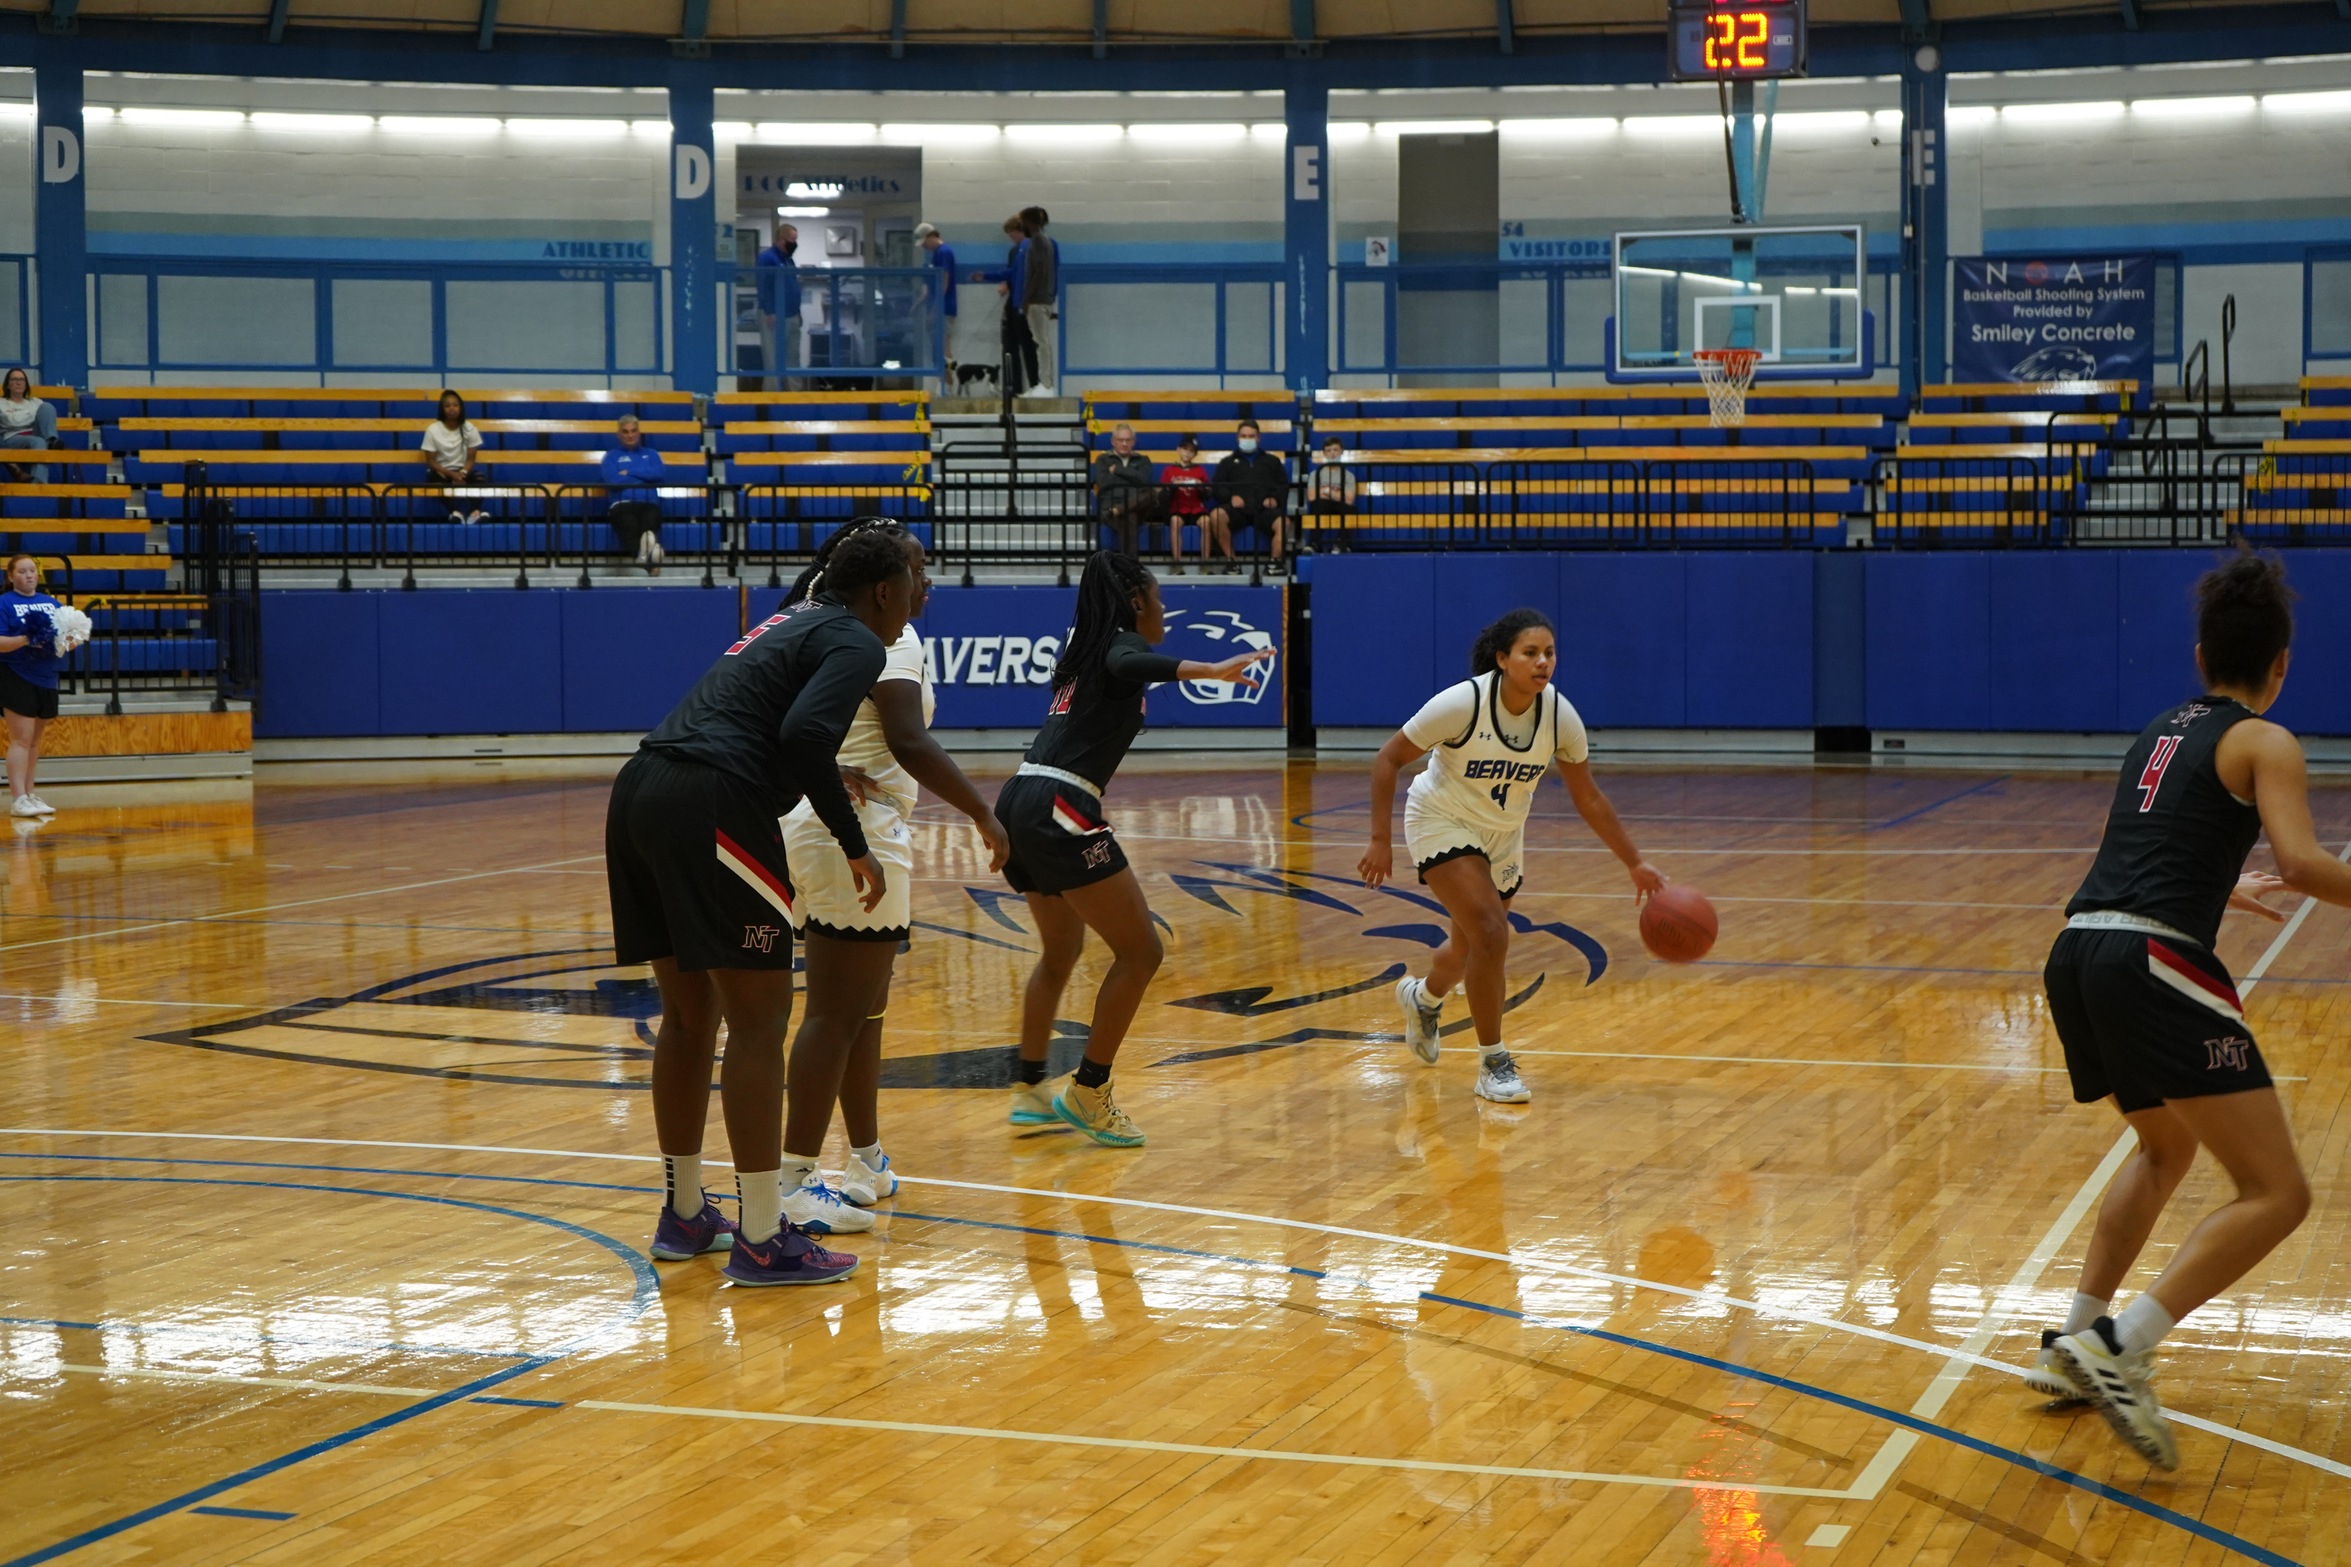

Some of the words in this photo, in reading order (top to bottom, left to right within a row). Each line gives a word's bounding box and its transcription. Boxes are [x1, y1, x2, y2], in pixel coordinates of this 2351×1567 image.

[1705, 12, 1768, 68] 22
[43, 125, 80, 183] D
[675, 144, 711, 199] D
[1293, 145, 1320, 200] E
[1911, 129, 1936, 186] E
[542, 241, 650, 259] ATHLETIC
[1963, 288, 2032, 302] Basketball
[2035, 288, 2094, 304] Shooting
[2097, 287, 2145, 303] System
[2013, 304, 2073, 319] Provided
[2076, 304, 2094, 320] by
[1971, 323, 2036, 345] Smiley
[2041, 322, 2136, 342] Concrete
[723, 613, 792, 656] 5
[1490, 783, 1511, 811] 4
[2137, 735, 2185, 813] 4
